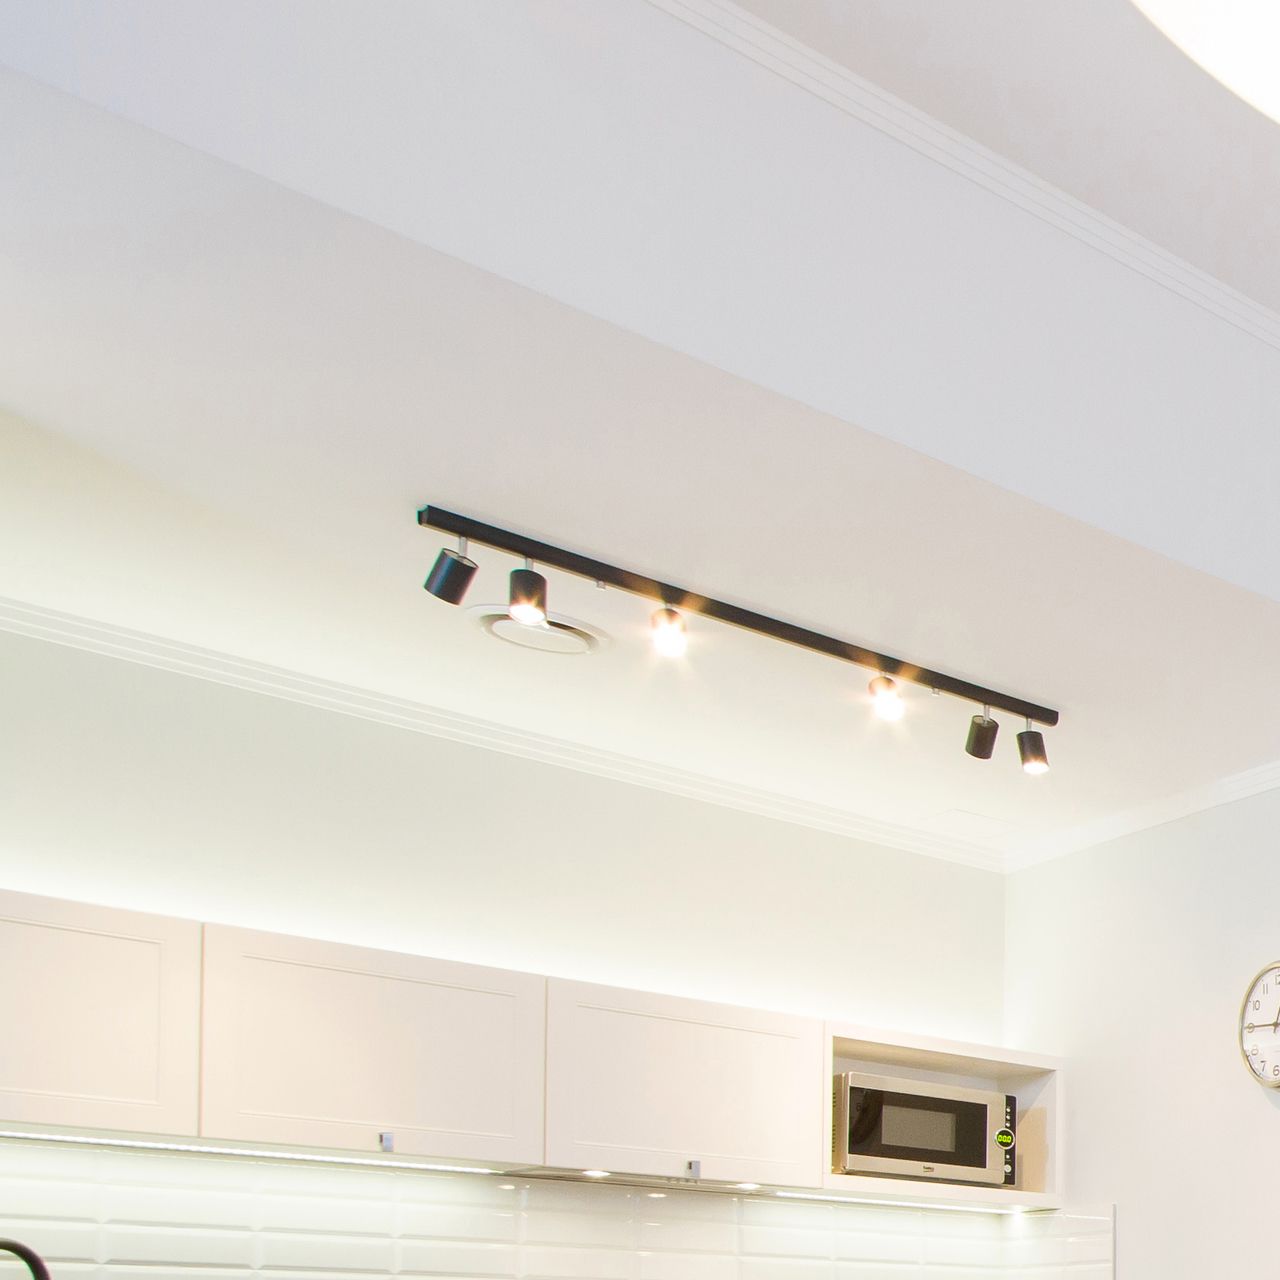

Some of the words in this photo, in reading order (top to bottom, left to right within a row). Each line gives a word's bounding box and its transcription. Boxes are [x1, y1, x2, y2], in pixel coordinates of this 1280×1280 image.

[1262, 984, 1269, 995] 11
[1252, 1000, 1261, 1011] 10
[1247, 1022, 1255, 1033] 9
[1251, 1045, 1259, 1056] 8
[1260, 1060, 1267, 1072] 7
[1272, 1065, 1280, 1077] 6
